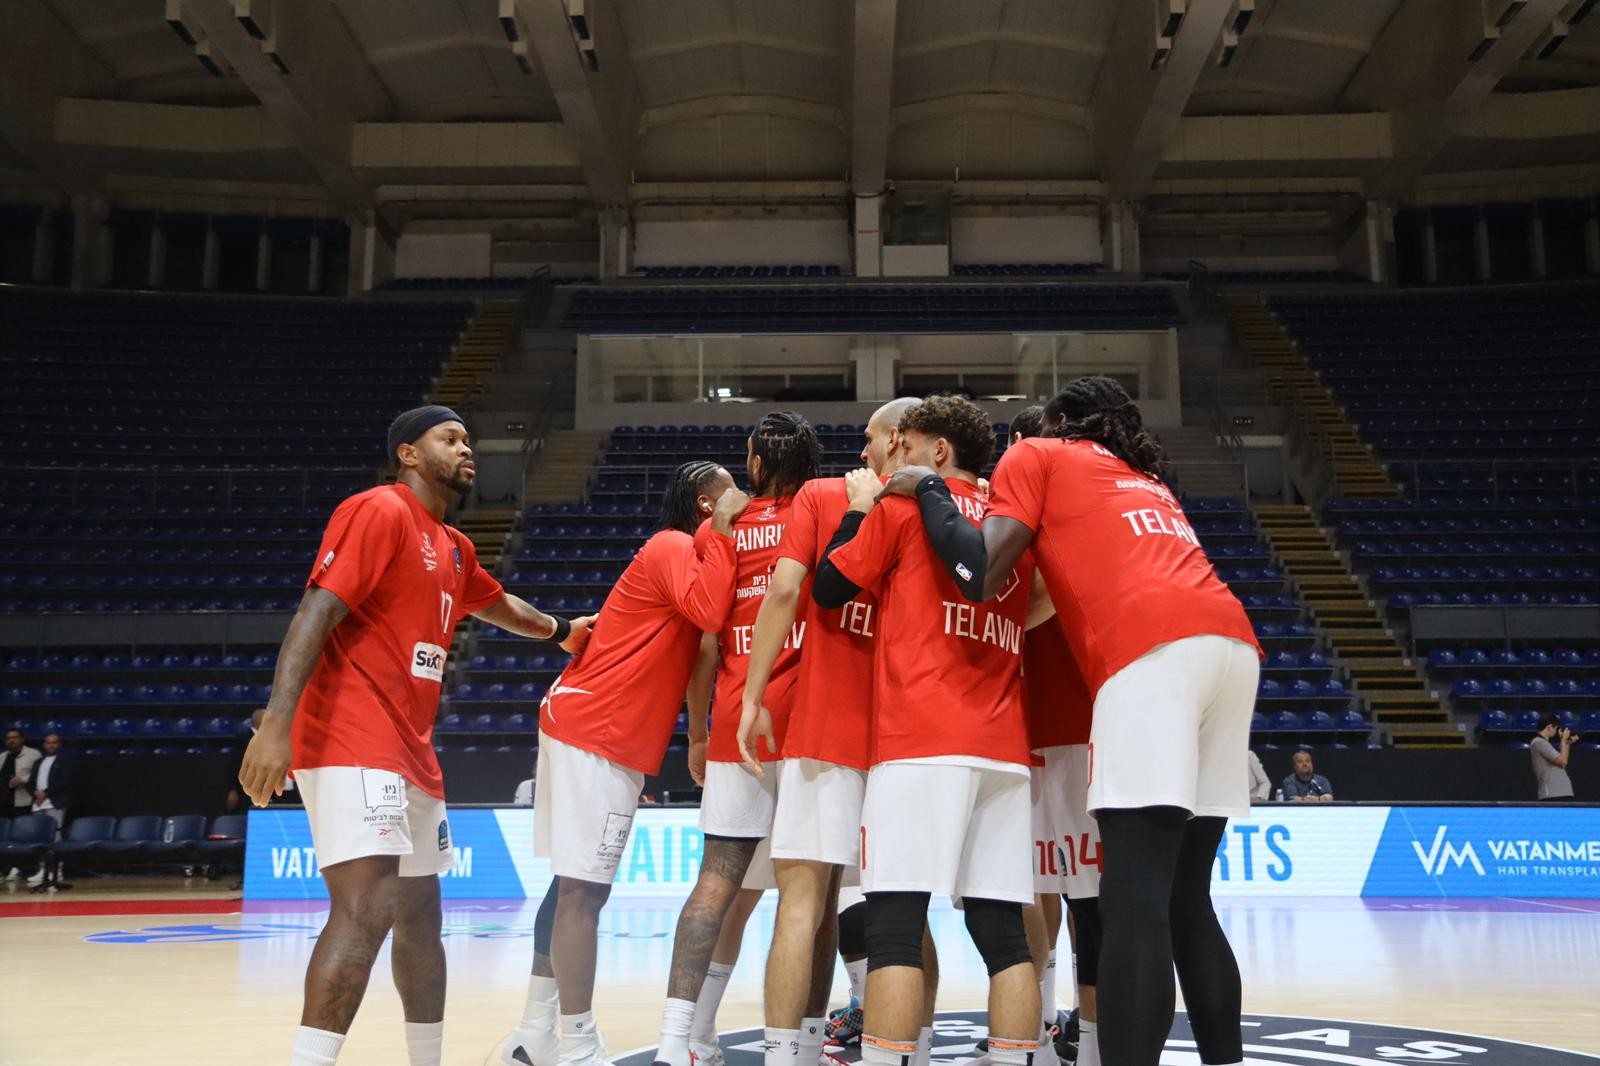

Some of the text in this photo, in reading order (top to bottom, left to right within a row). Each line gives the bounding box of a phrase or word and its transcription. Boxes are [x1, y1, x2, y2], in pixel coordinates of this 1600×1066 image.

[951, 493, 987, 521] YAA
[732, 523, 786, 552] AINRI
[1121, 508, 1201, 548] TEL AV
[736, 584, 767, 599] השקעות
[753, 575, 766, 586] בית
[441, 590, 453, 633] 17
[839, 600, 873, 637] TEL
[733, 625, 756, 654] TE
[942, 600, 1021, 655] TEL AVIV
[271, 847, 321, 878] VAT
[614, 825, 704, 883] AIR
[1065, 833, 1103, 876] 14
[1412, 825, 1486, 876] VM
[1488, 840, 1600, 862] VATANME
[1498, 866, 1600, 876] HAIR TRANSPLA
